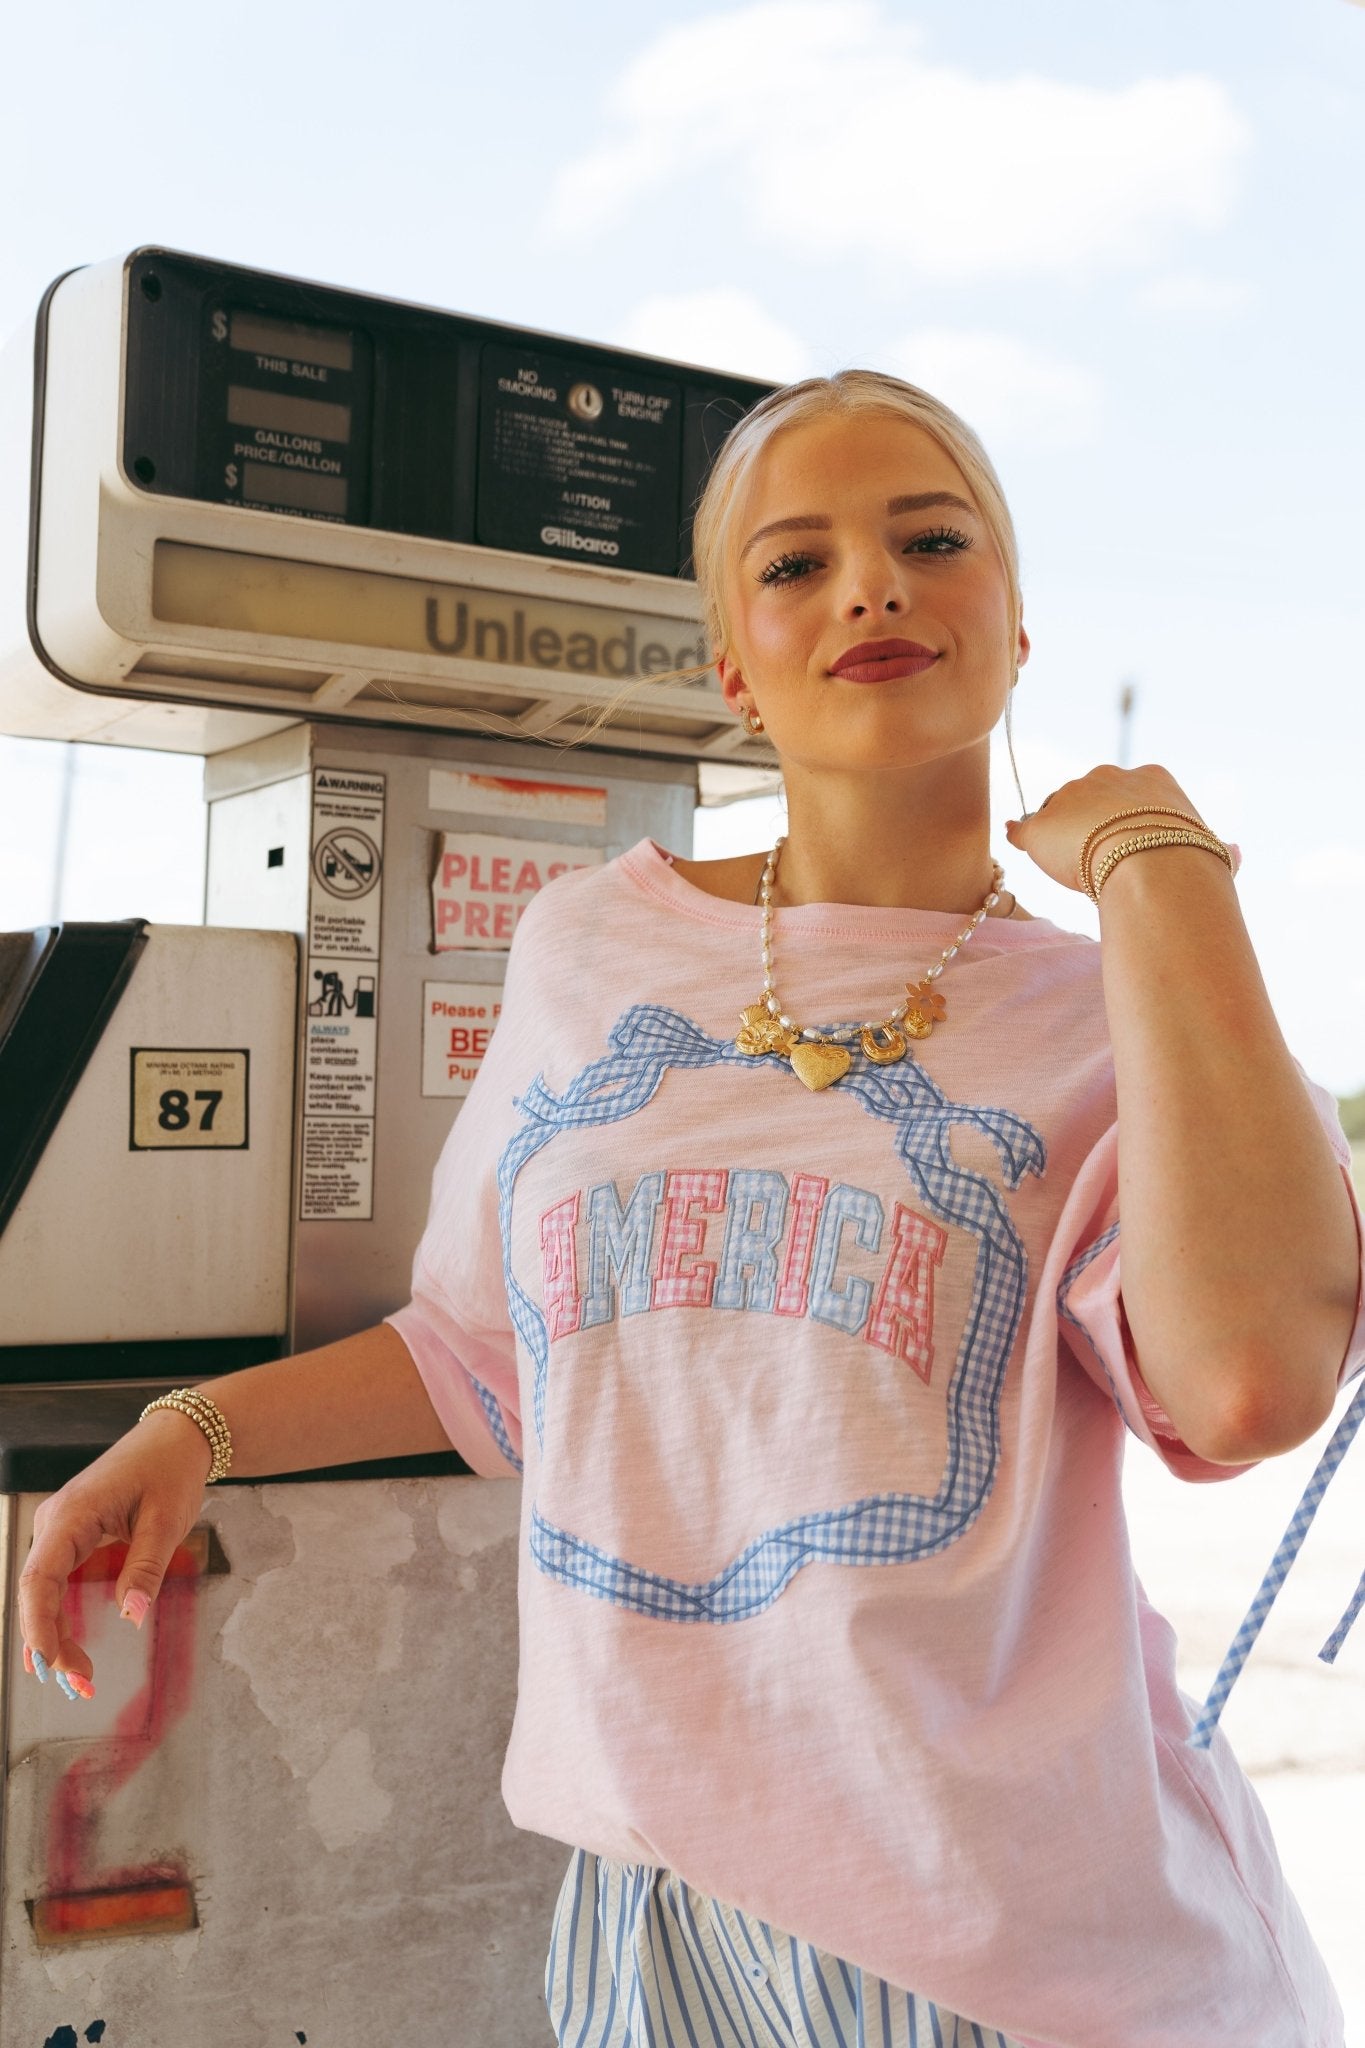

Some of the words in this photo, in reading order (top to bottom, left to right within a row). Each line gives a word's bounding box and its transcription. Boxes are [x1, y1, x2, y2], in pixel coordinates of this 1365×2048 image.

[212, 311, 227, 341] $
[256, 356, 288, 374] THIS
[292, 365, 327, 382] SALE
[518, 369, 538, 384] NO
[498, 378, 557, 402] SMOKING
[611, 388, 645, 405] TURN
[646, 395, 672, 410] OFF
[618, 404, 663, 423] ENGINE
[255, 431, 322, 454] GALLONS
[225, 463, 238, 489] $
[558, 490, 612, 511] AUTION
[540, 526, 620, 556] Gilbarco
[426, 597, 707, 686] Unleaded
[329, 779, 383, 793] WARNING
[442, 853, 590, 894] PLEA
[328, 916, 365, 926] portable
[436, 898, 528, 939] PRE
[314, 925, 362, 934] containers
[314, 933, 332, 941] that
[352, 935, 360, 943] in
[432, 1001, 486, 1018] Please
[311, 1025, 350, 1036] ALWAYS
[311, 1036, 336, 1044] place
[451, 1028, 495, 1053] BE
[310, 1047, 359, 1055] containers
[310, 1057, 322, 1065] on
[146, 1062, 178, 1070] MINIMUM
[180, 1062, 208, 1070] OCTANE
[210, 1062, 236, 1070] RATING
[310, 1073, 332, 1082] Keep
[335, 1073, 362, 1081] nozzle
[347, 1083, 366, 1091] with
[158, 1089, 223, 1131] 87
[538, 1168, 948, 1386] AMERICA
